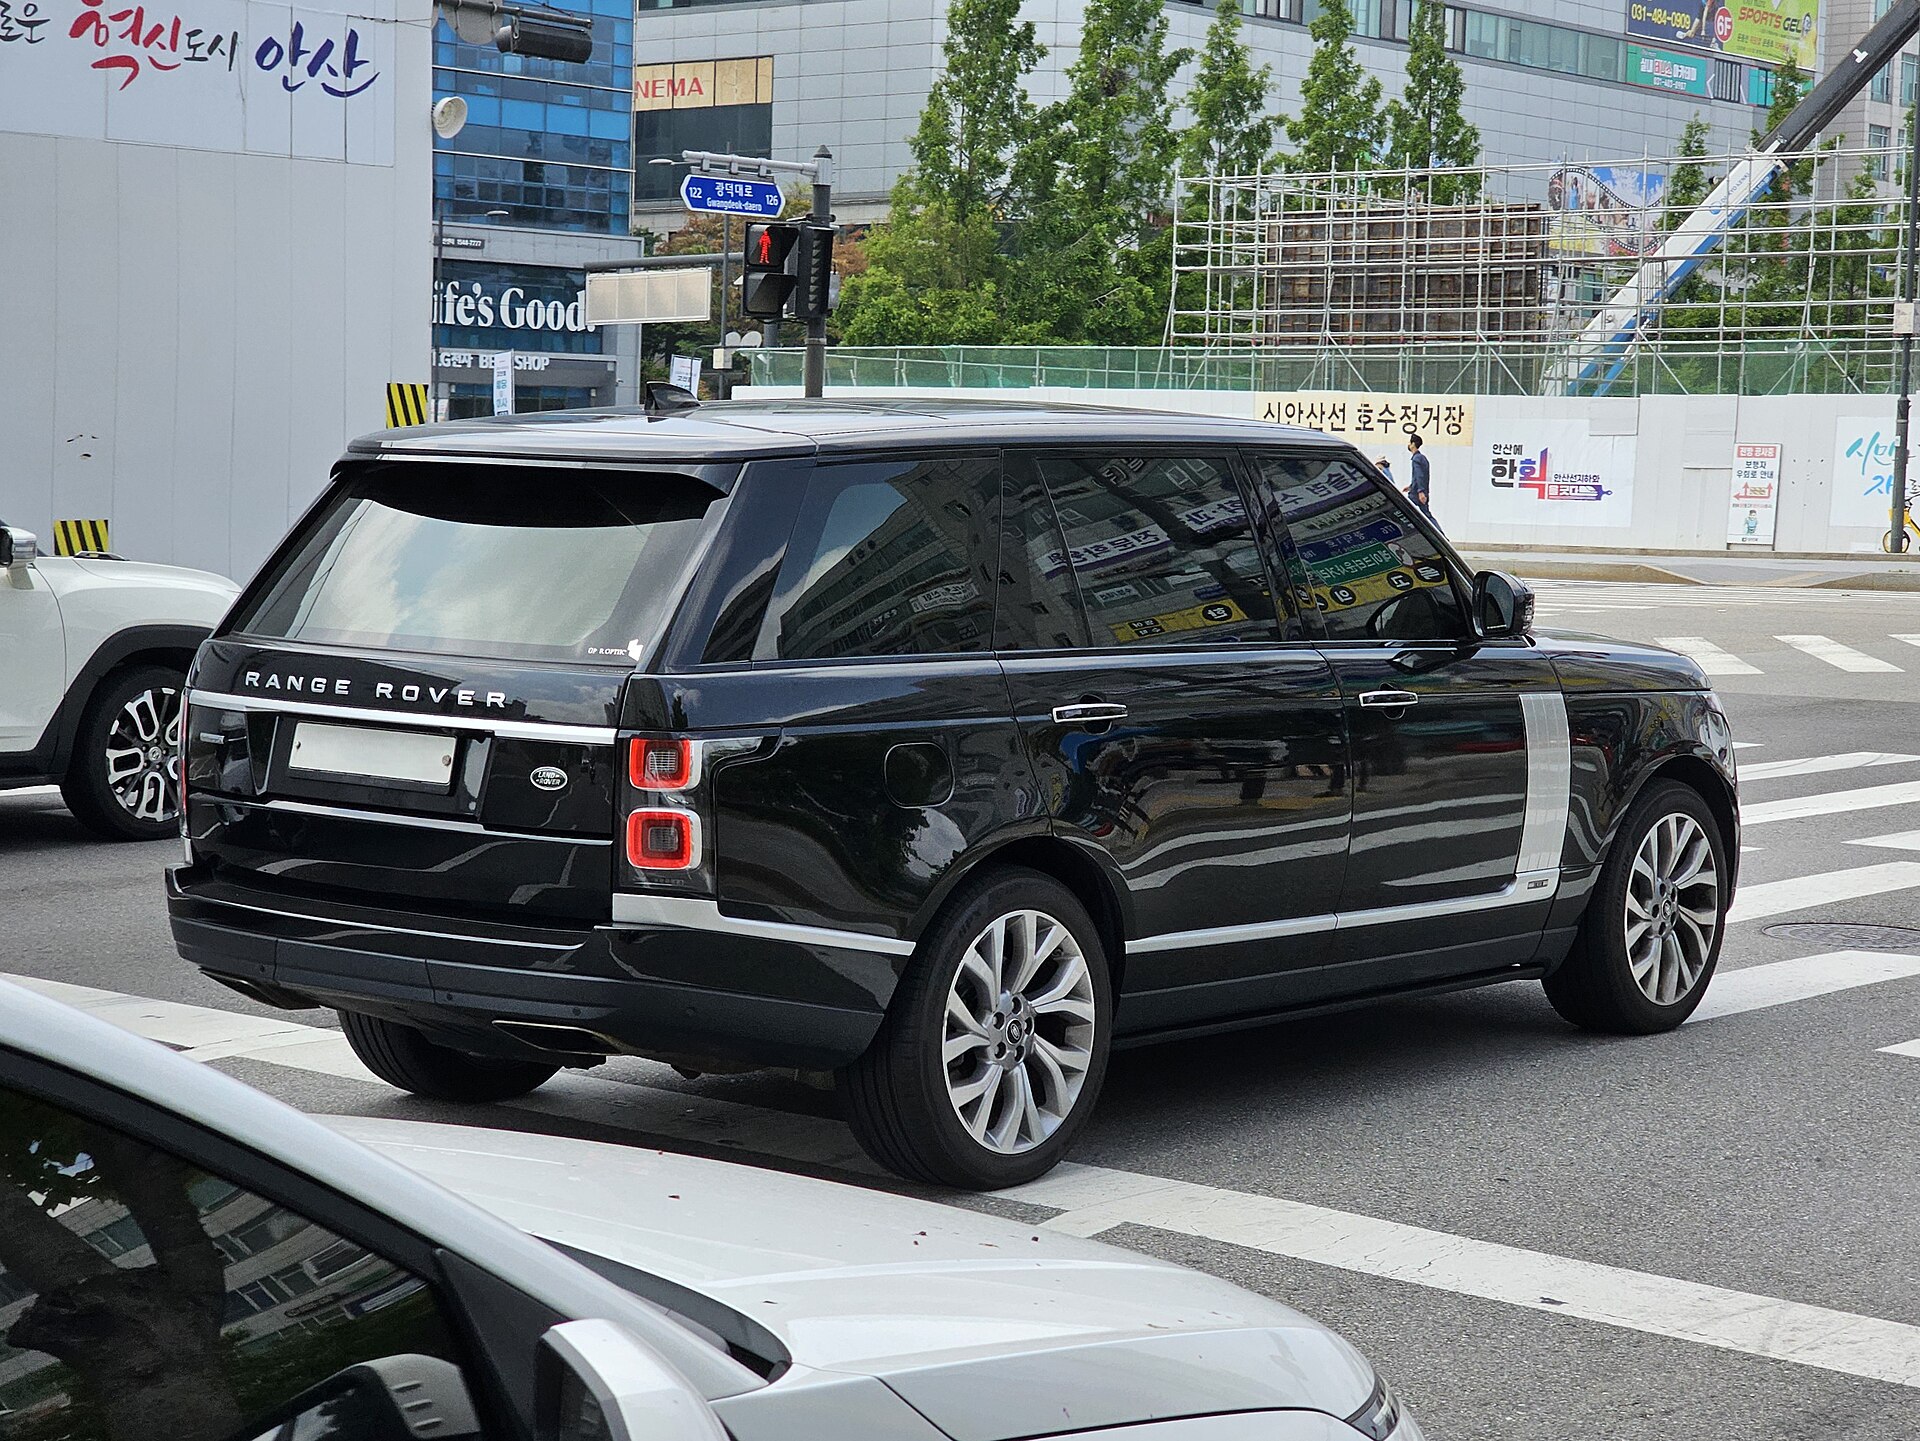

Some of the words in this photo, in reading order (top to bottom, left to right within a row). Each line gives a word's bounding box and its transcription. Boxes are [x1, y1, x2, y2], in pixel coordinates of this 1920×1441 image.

[1716, 13, 1732, 36] 6F
[1738, 6, 1782, 29] SPORTS
[255, 21, 380, 97] 안산
[635, 77, 704, 99] NEMA
[688, 187, 702, 199] 122
[715, 182, 754, 197] 광덕대로
[706, 197, 762, 212] Gwangdeok-daero
[765, 194, 779, 206] 126
[514, 355, 550, 371] SHOP
[1355, 403, 1465, 435] 호수정거장
[1492, 443, 1523, 455] 안산에
[1745, 461, 1766, 469] 보행자
[1737, 470, 1757, 479] 우회로
[1760, 470, 1774, 479] 안내
[245, 671, 351, 696] RANGE
[375, 683, 506, 708] ROVER
